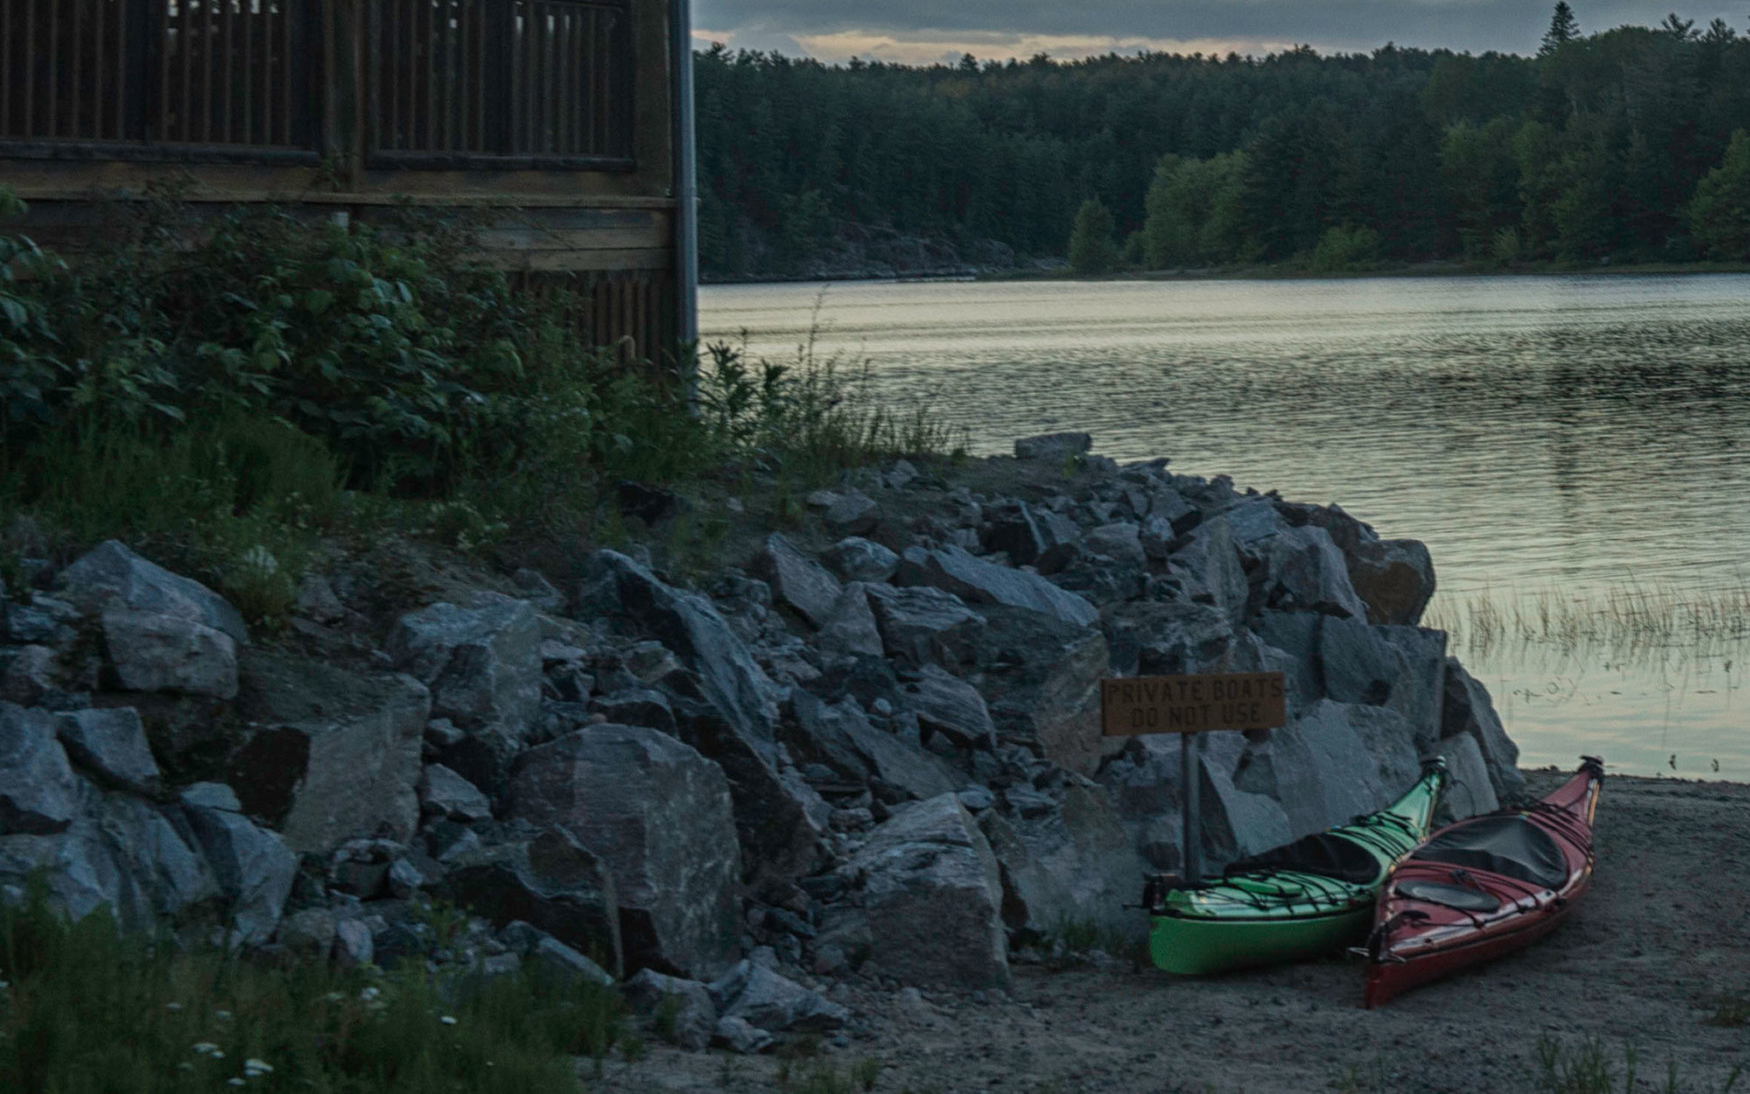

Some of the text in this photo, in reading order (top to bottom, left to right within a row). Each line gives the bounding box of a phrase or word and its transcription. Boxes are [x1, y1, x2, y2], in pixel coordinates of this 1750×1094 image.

[1108, 678, 1282, 703] PRIVATE BOATS
[1131, 703, 1261, 727] DO NOT USE
